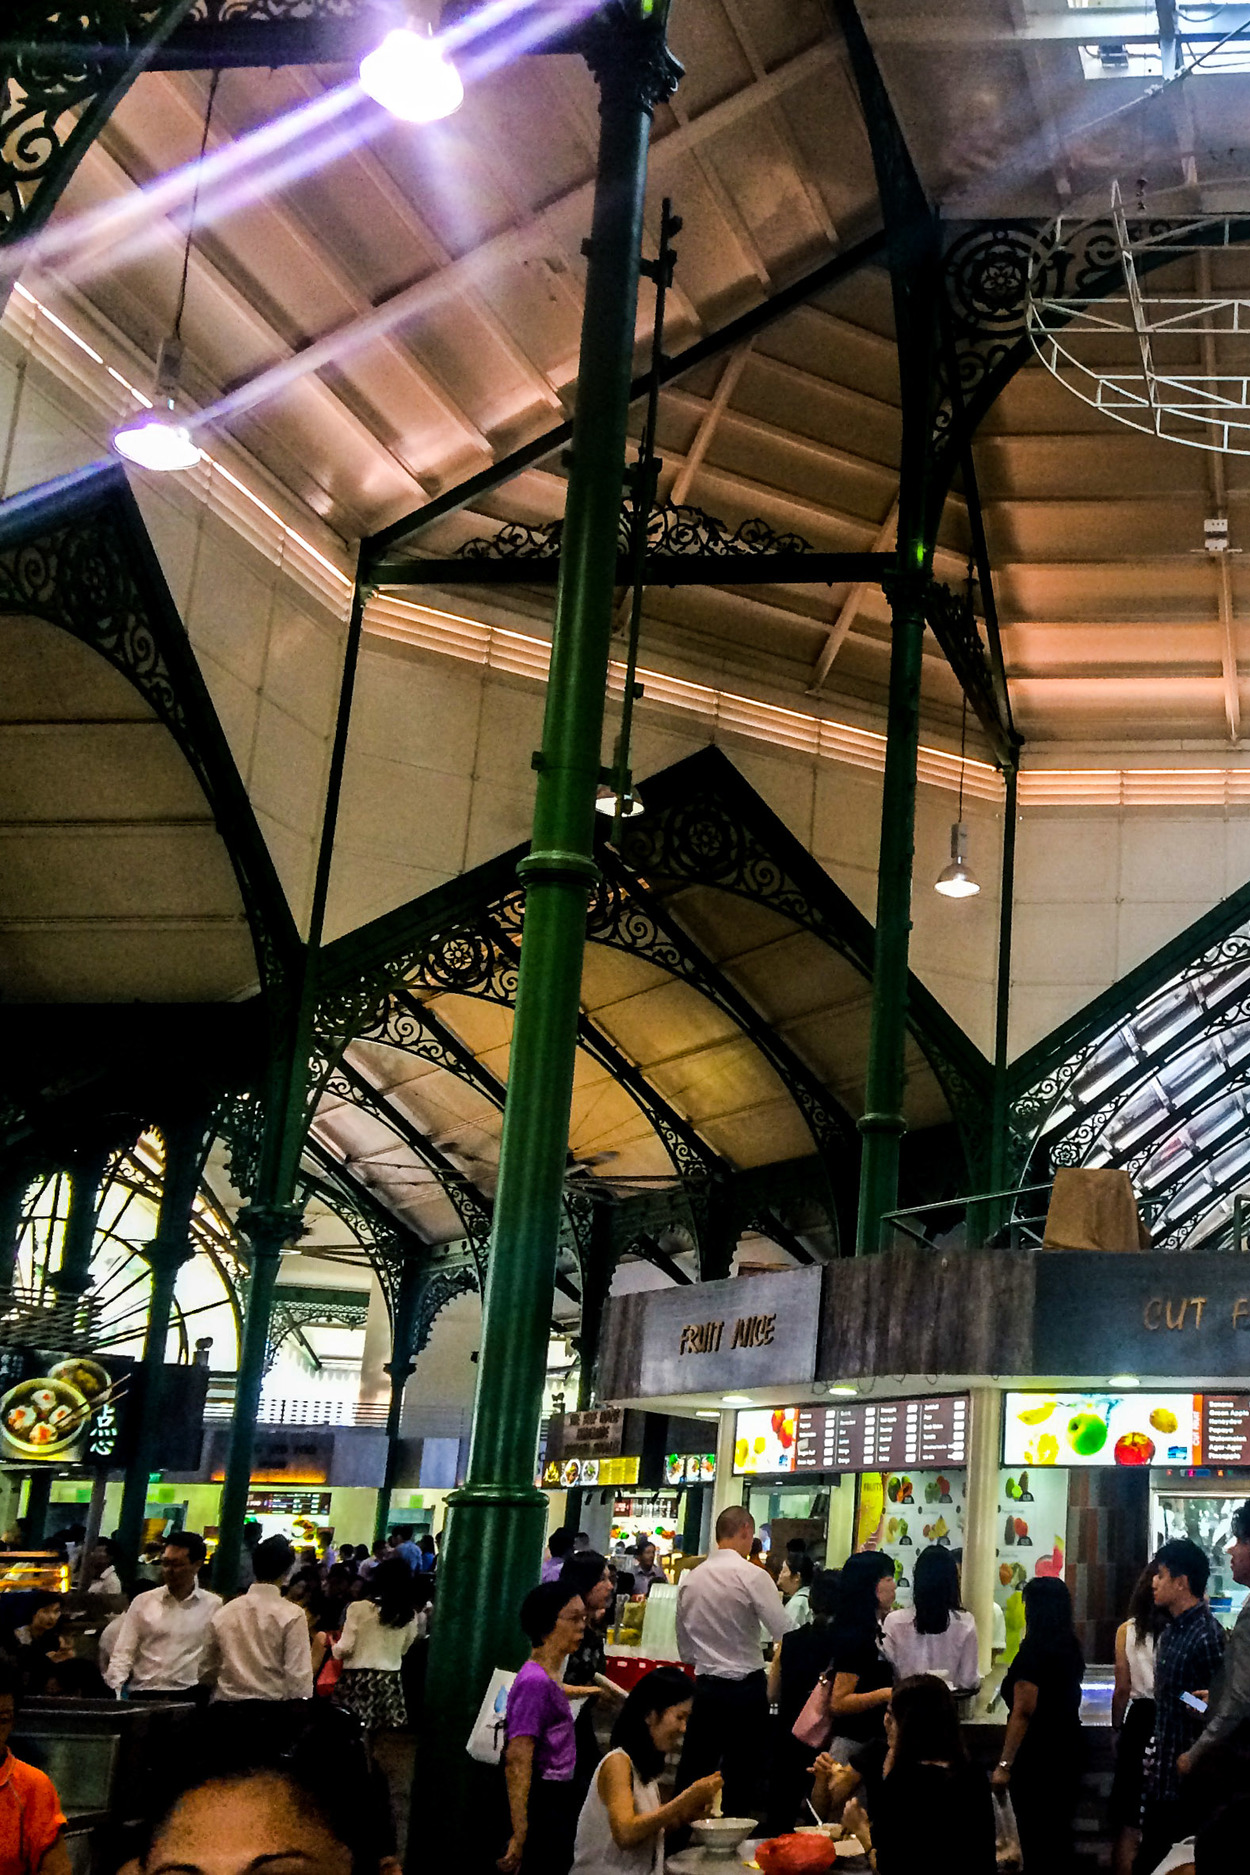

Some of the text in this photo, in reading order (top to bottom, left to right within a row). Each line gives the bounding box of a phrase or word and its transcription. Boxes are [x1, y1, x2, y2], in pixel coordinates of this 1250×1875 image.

[1143, 1296, 1207, 1330] CUT
[680, 1321, 725, 1355] FRUIT
[89, 1403, 118, 1456] 点心
